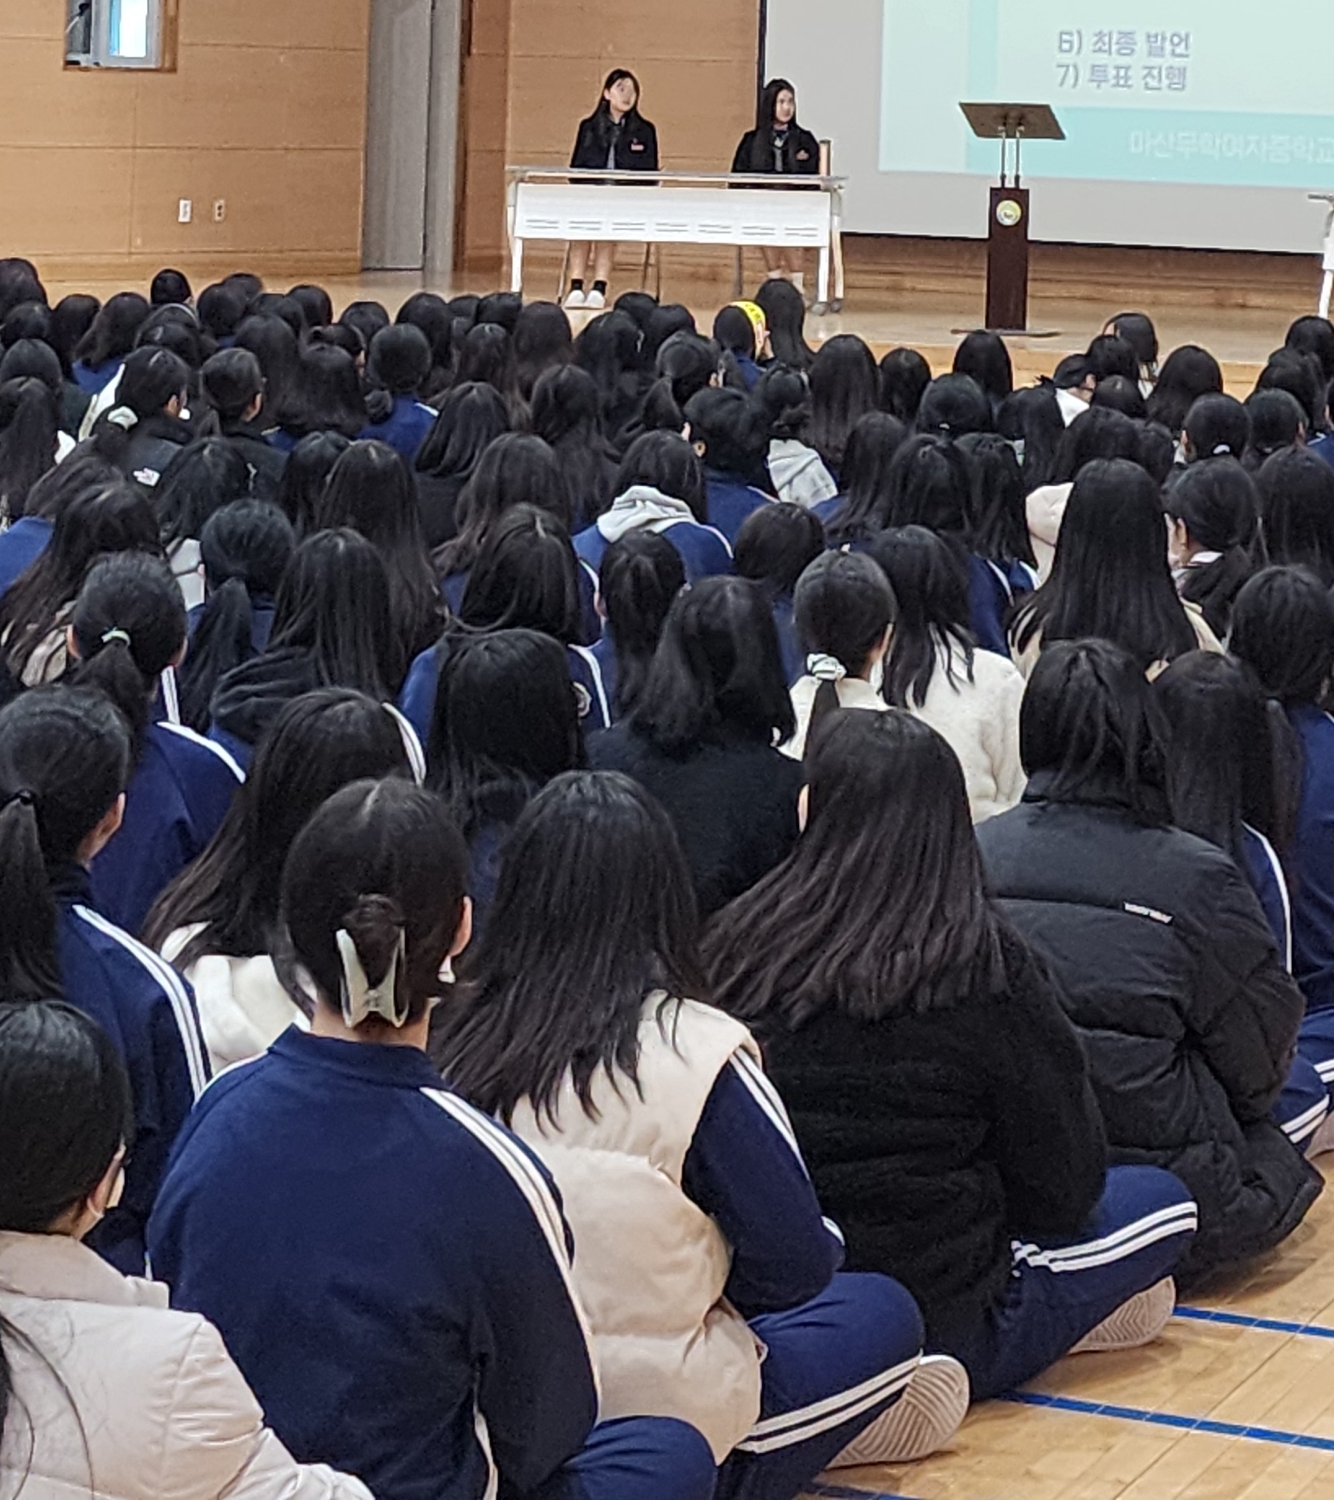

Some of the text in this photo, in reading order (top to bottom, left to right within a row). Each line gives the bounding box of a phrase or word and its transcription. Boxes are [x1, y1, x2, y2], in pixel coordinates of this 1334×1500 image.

[1058, 29, 1191, 58] 6) 최종 발언
[1056, 62, 1187, 91] 7) 투표 진행
